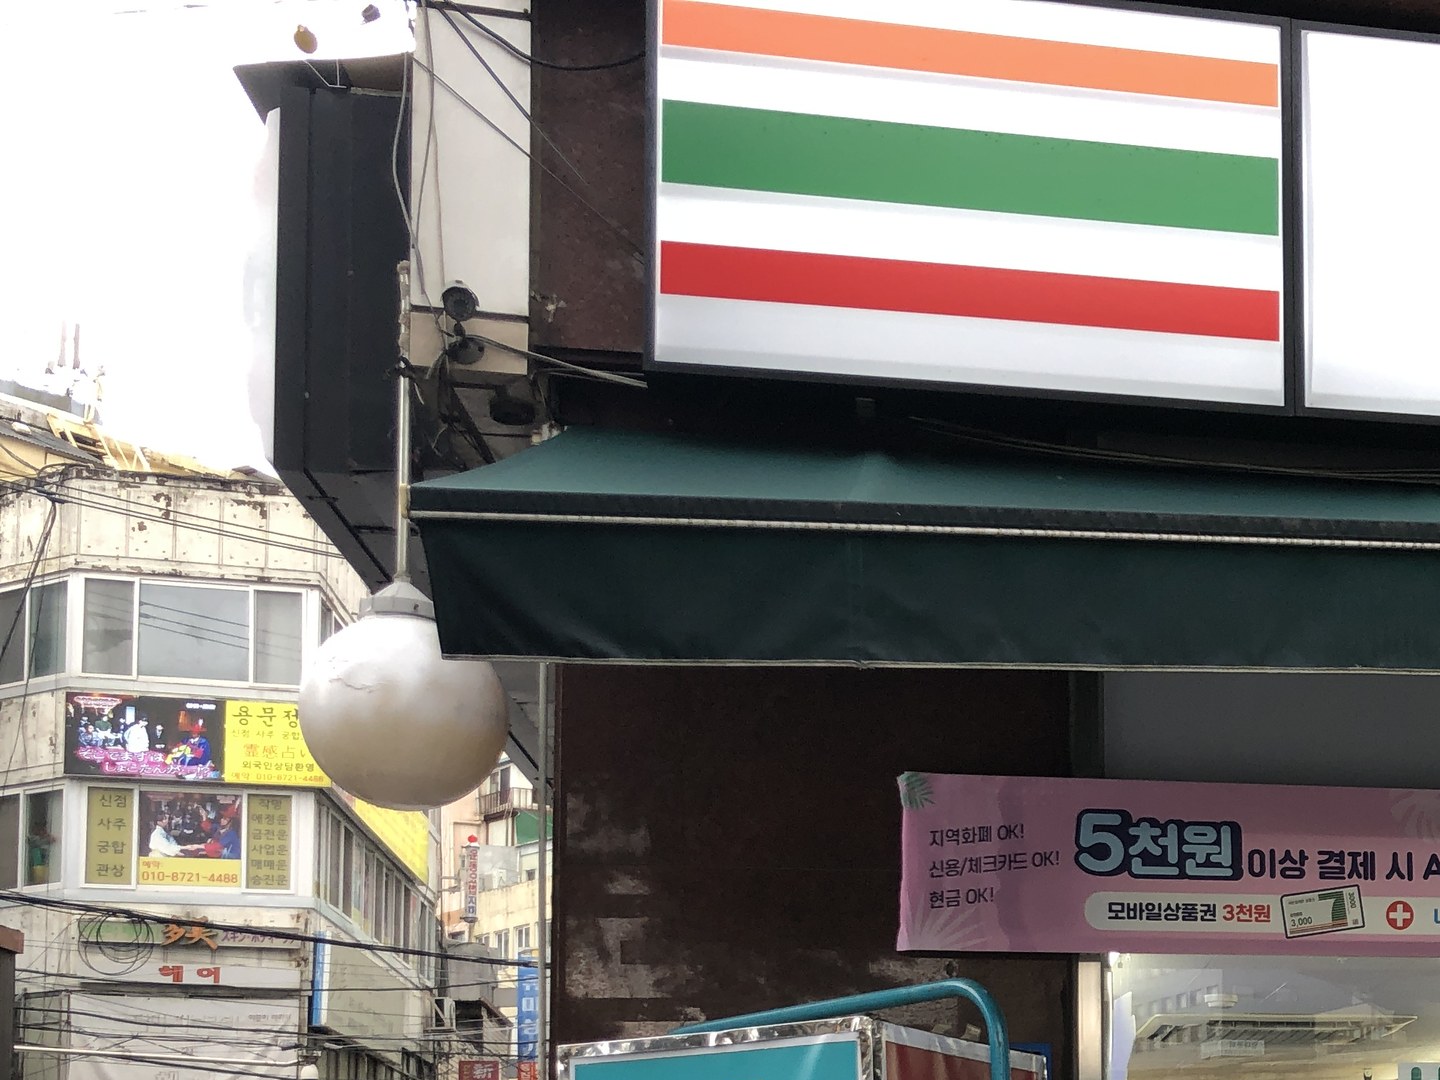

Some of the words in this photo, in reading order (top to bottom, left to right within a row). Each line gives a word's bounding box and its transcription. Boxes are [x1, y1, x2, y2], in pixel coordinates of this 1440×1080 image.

[101, 794, 127, 808] 신점
[97, 818, 127, 831] 사주
[928, 826, 993, 848] 지역화폐
[997, 823, 1025, 843] OK!
[97, 840, 126, 854] 궁합
[1076, 811, 1240, 881] 5천원
[1248, 848, 1308, 881] 이상
[1317, 849, 1376, 882] 결제
[1385, 851, 1413, 883] 시
[96, 864, 125, 877] 관상
[928, 850, 1029, 880] 신용/체크카드
[1031, 850, 1061, 870] OK!
[142, 870, 239, 883] 010-8721-4488
[928, 888, 962, 909] 현금
[965, 886, 995, 905] OK!
[1106, 901, 1218, 923] 모바일상품권
[1222, 903, 1272, 924] 3천원
